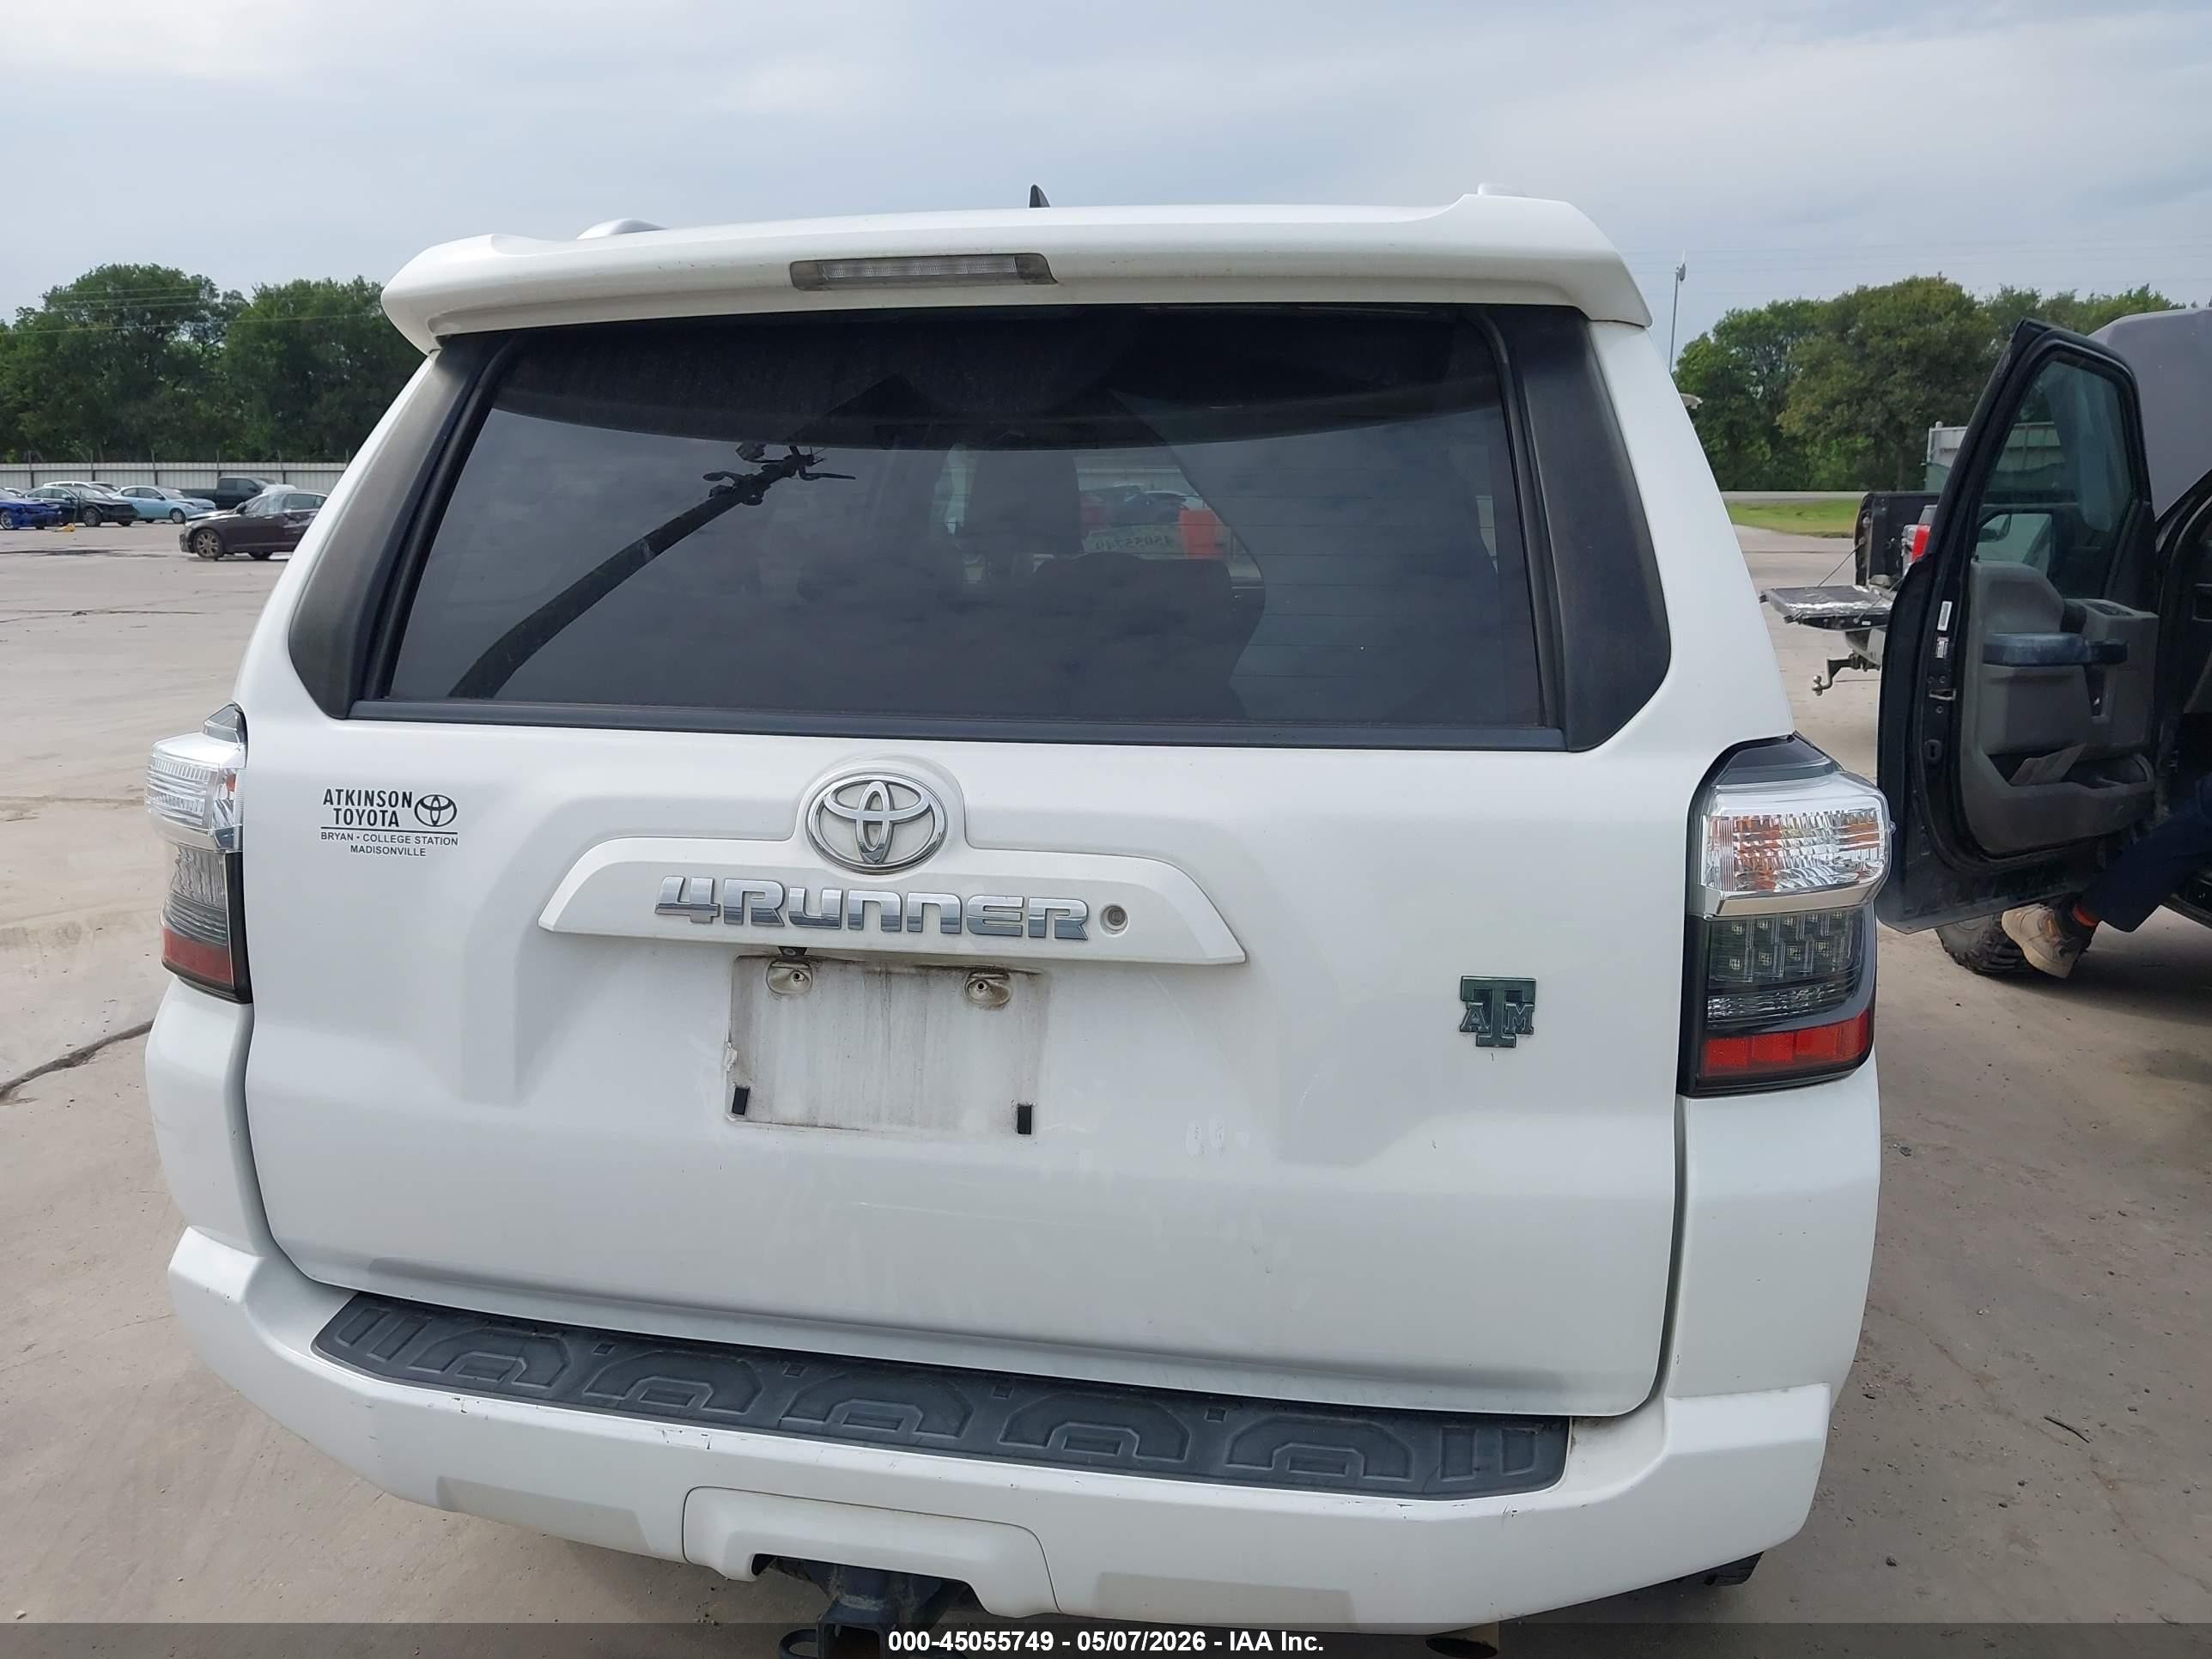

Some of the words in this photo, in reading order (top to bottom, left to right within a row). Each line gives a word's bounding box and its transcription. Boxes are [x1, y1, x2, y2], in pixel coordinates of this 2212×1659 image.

[322, 788, 413, 809] ATKINSON
[333, 808, 399, 827] TOYOTA
[320, 831, 354, 842] BRYAN
[362, 833, 411, 844] COLLEGE
[414, 836, 458, 846] STATION
[350, 845, 426, 856] MADISONVILLE
[654, 875, 1089, 941] 4RUNNER
